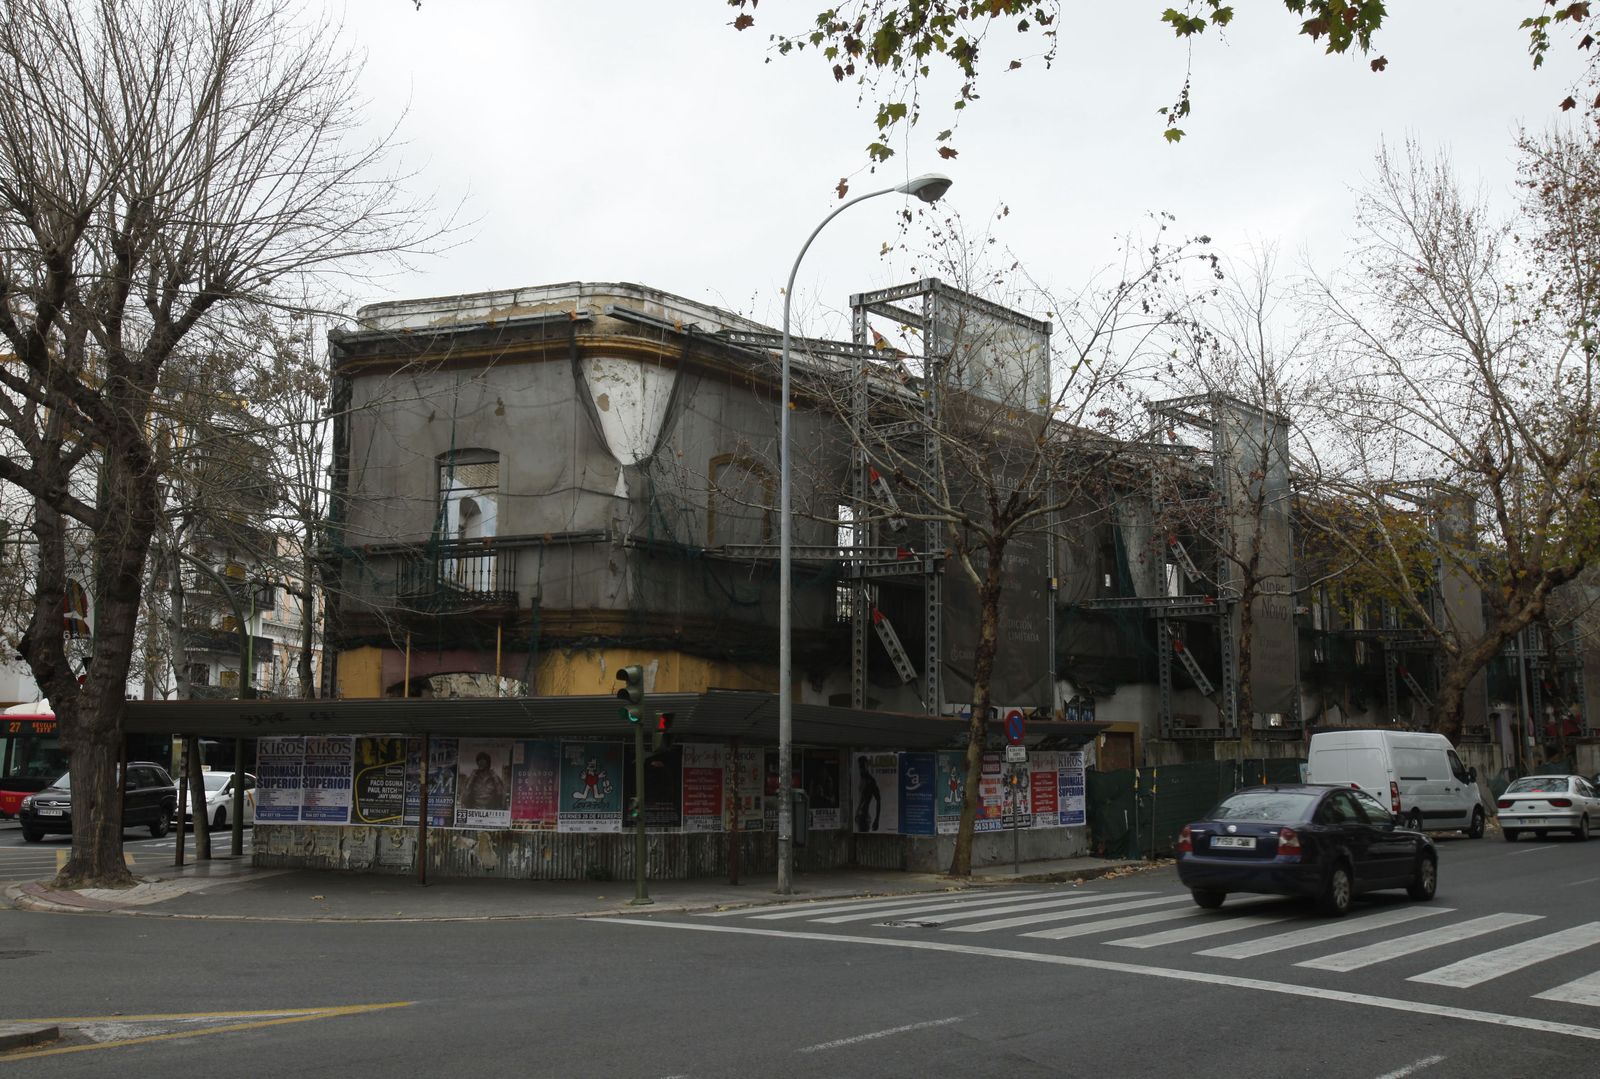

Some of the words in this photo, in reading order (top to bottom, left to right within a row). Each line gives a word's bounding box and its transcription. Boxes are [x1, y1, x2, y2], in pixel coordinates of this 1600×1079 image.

[9, 721, 22, 733] 27
[258, 743, 304, 755] KIROS
[305, 742, 351, 755] KIROS
[1058, 756, 1083, 767] KIROS
[256, 765, 302, 778] QUIROMASAJ
[303, 765, 351, 778] QUIROMASAJE
[302, 777, 351, 789] SUPERIOR
[1058, 786, 1084, 798] SUPERIOR
